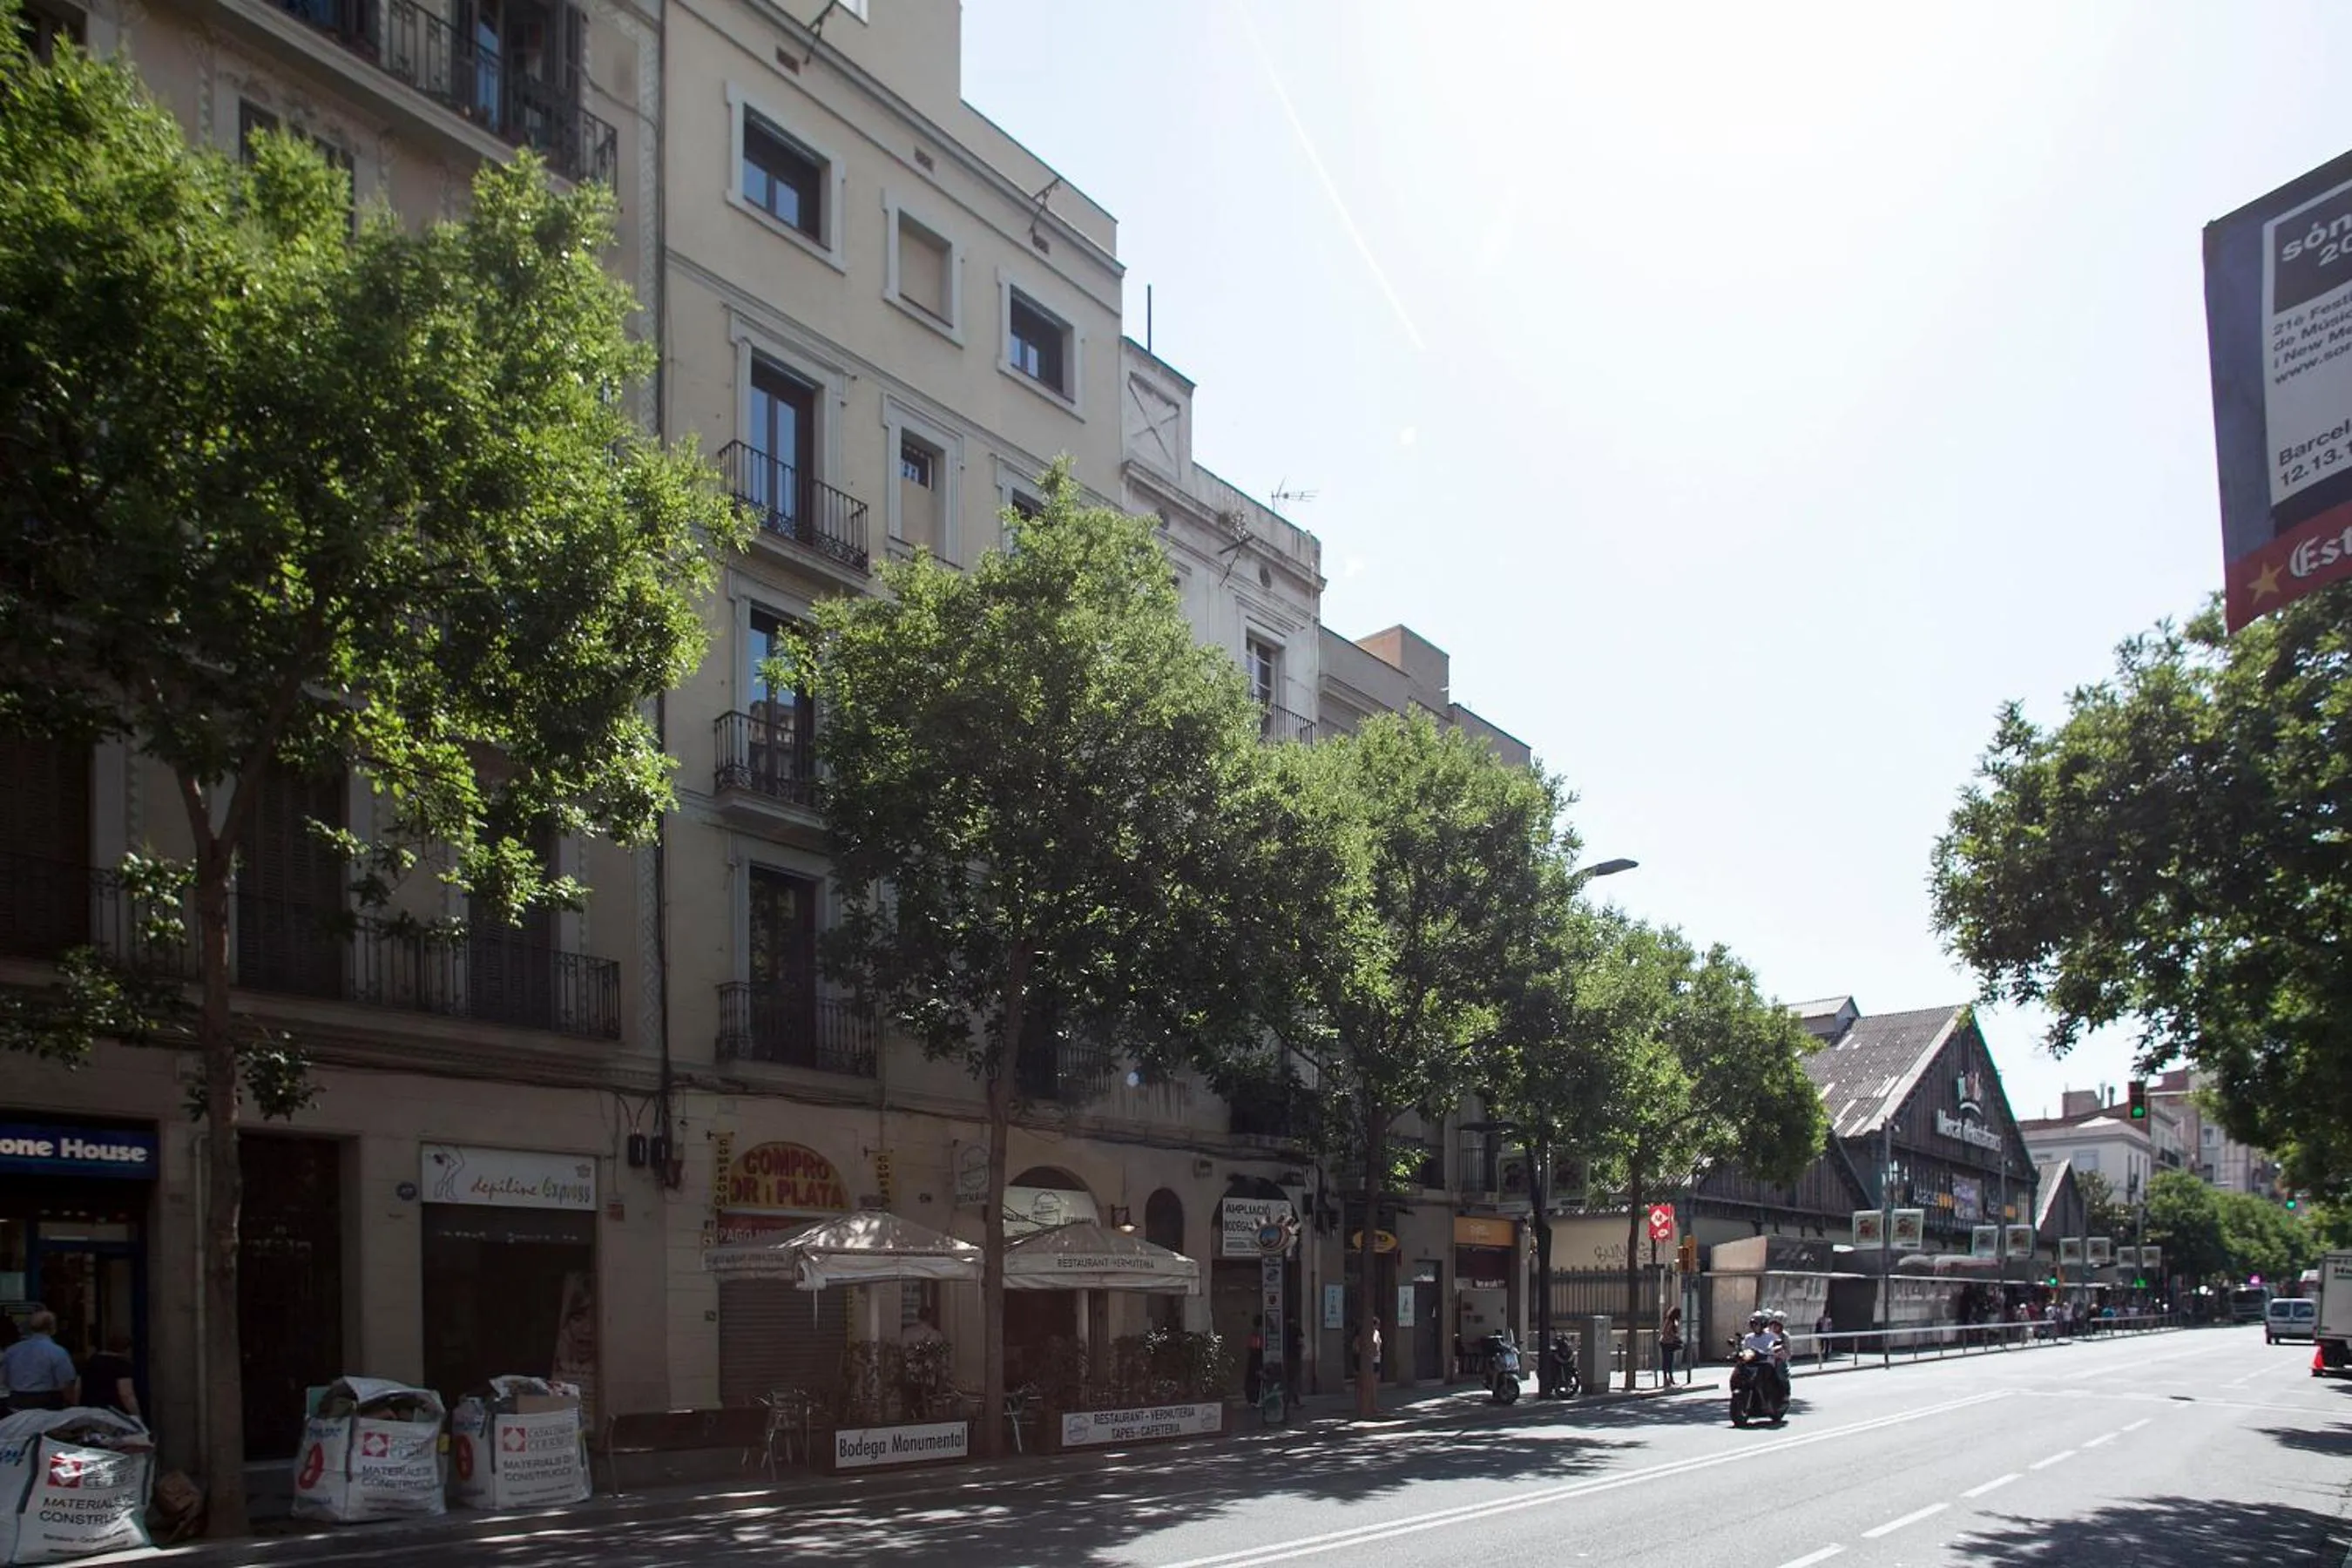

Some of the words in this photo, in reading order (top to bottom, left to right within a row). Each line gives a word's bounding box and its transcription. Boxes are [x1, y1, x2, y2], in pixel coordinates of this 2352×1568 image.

[2274, 336, 2295, 352] de
[2284, 339, 2323, 363] New
[58, 1136, 149, 1163] House
[743, 1146, 830, 1180] COMPRO
[776, 1179, 845, 1209] PLATA
[839, 1436, 887, 1459] Bodega
[891, 1427, 966, 1454] Monumental
